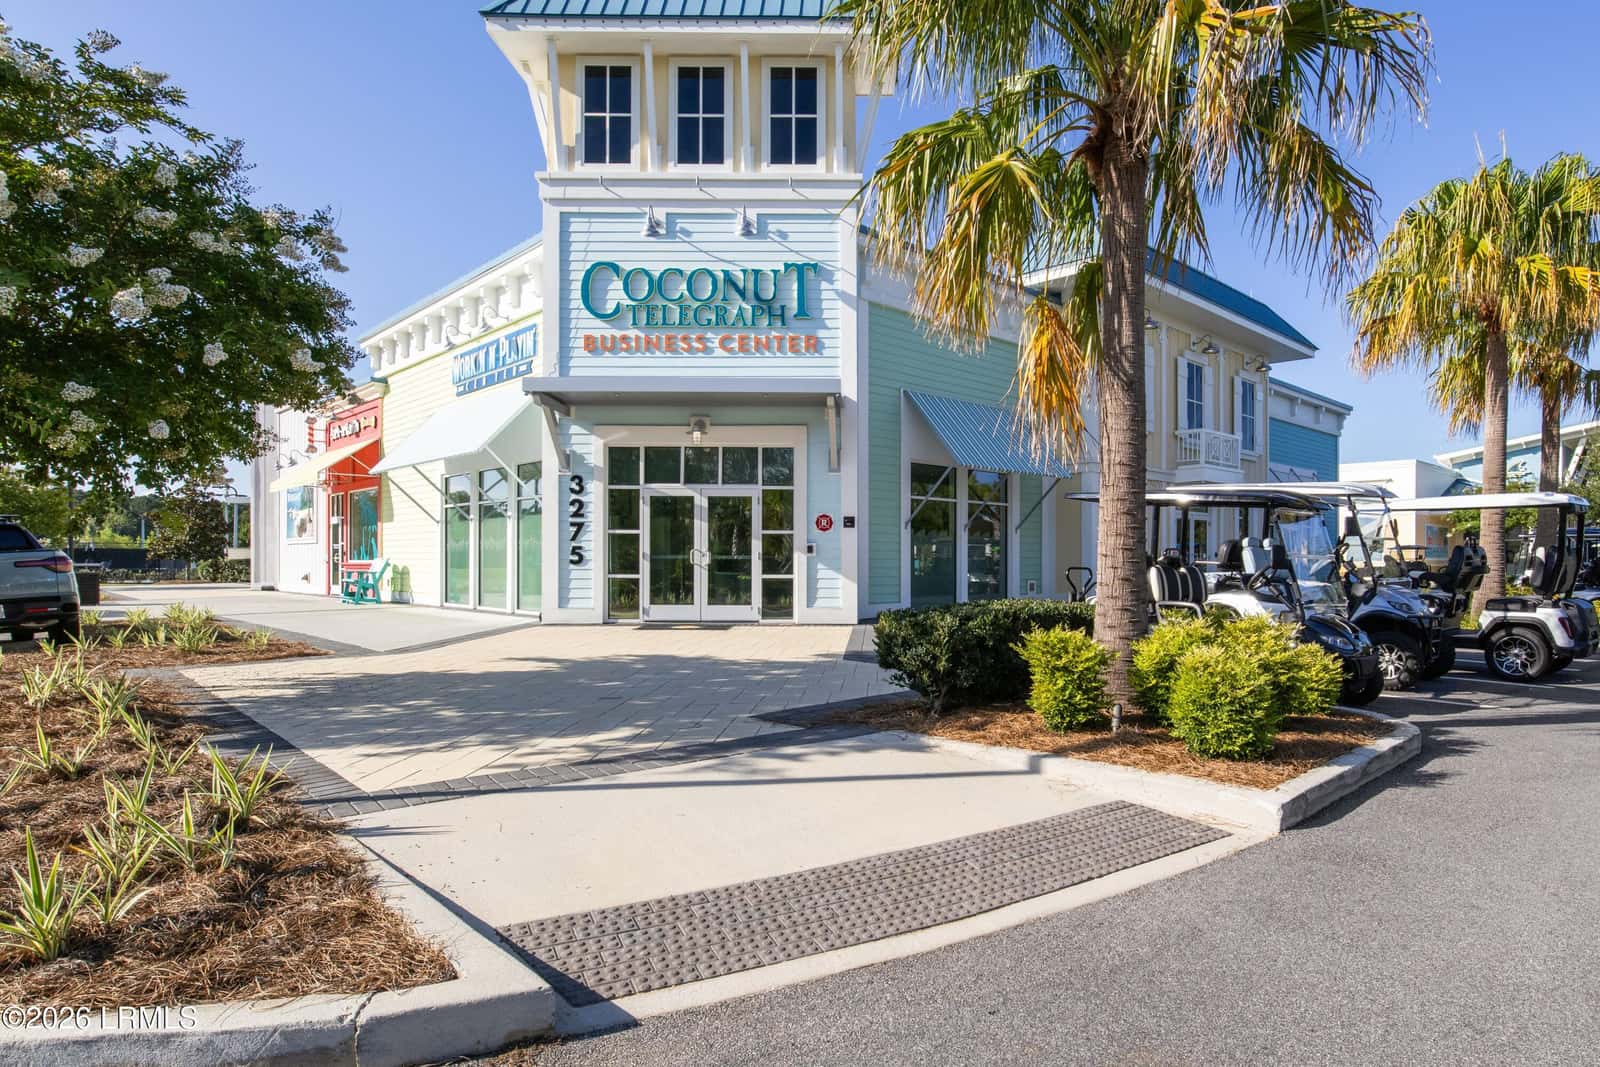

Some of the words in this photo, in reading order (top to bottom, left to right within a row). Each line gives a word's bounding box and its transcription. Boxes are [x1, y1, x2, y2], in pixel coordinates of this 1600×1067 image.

[581, 261, 819, 320] COCONUT
[626, 304, 787, 327] TELEGRAPH
[583, 334, 706, 352] BUSINESS
[718, 334, 818, 353] CENTER
[568, 474, 585, 565] 3275
